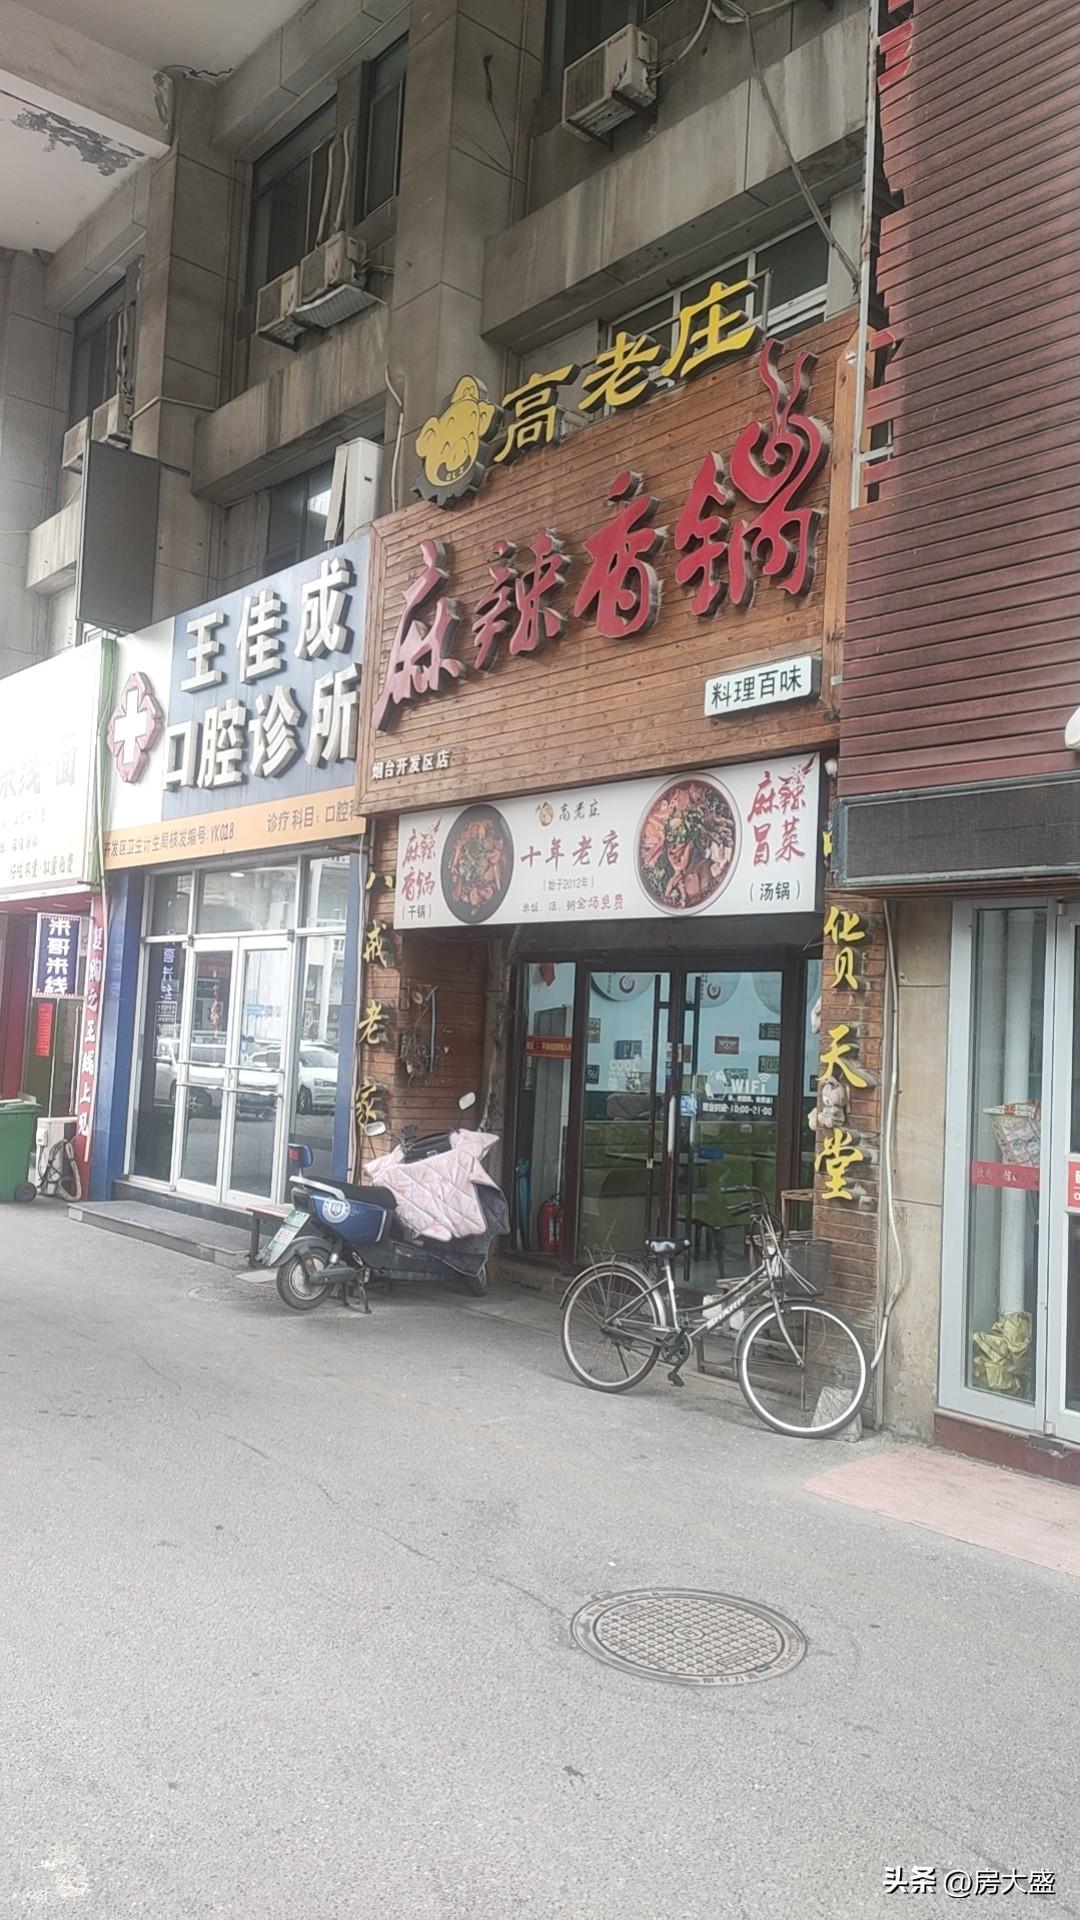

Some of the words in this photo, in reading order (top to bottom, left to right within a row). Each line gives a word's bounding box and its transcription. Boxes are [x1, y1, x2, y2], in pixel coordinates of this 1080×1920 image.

[495, 280, 763, 463] 高老庄
[372, 338, 828, 731] 麻辣香锅
[180, 557, 357, 694] 王佳成
[162, 662, 363, 791] 口腔诊所
[710, 667, 803, 708] 料理百味
[371, 749, 450, 779] 烟台开发区店
[520, 829, 620, 871] 十年老店
[559, 798, 601, 821] 高老庄
[753, 816, 806, 868] 冒菜
[356, 872, 394, 1129] 八戒老家
